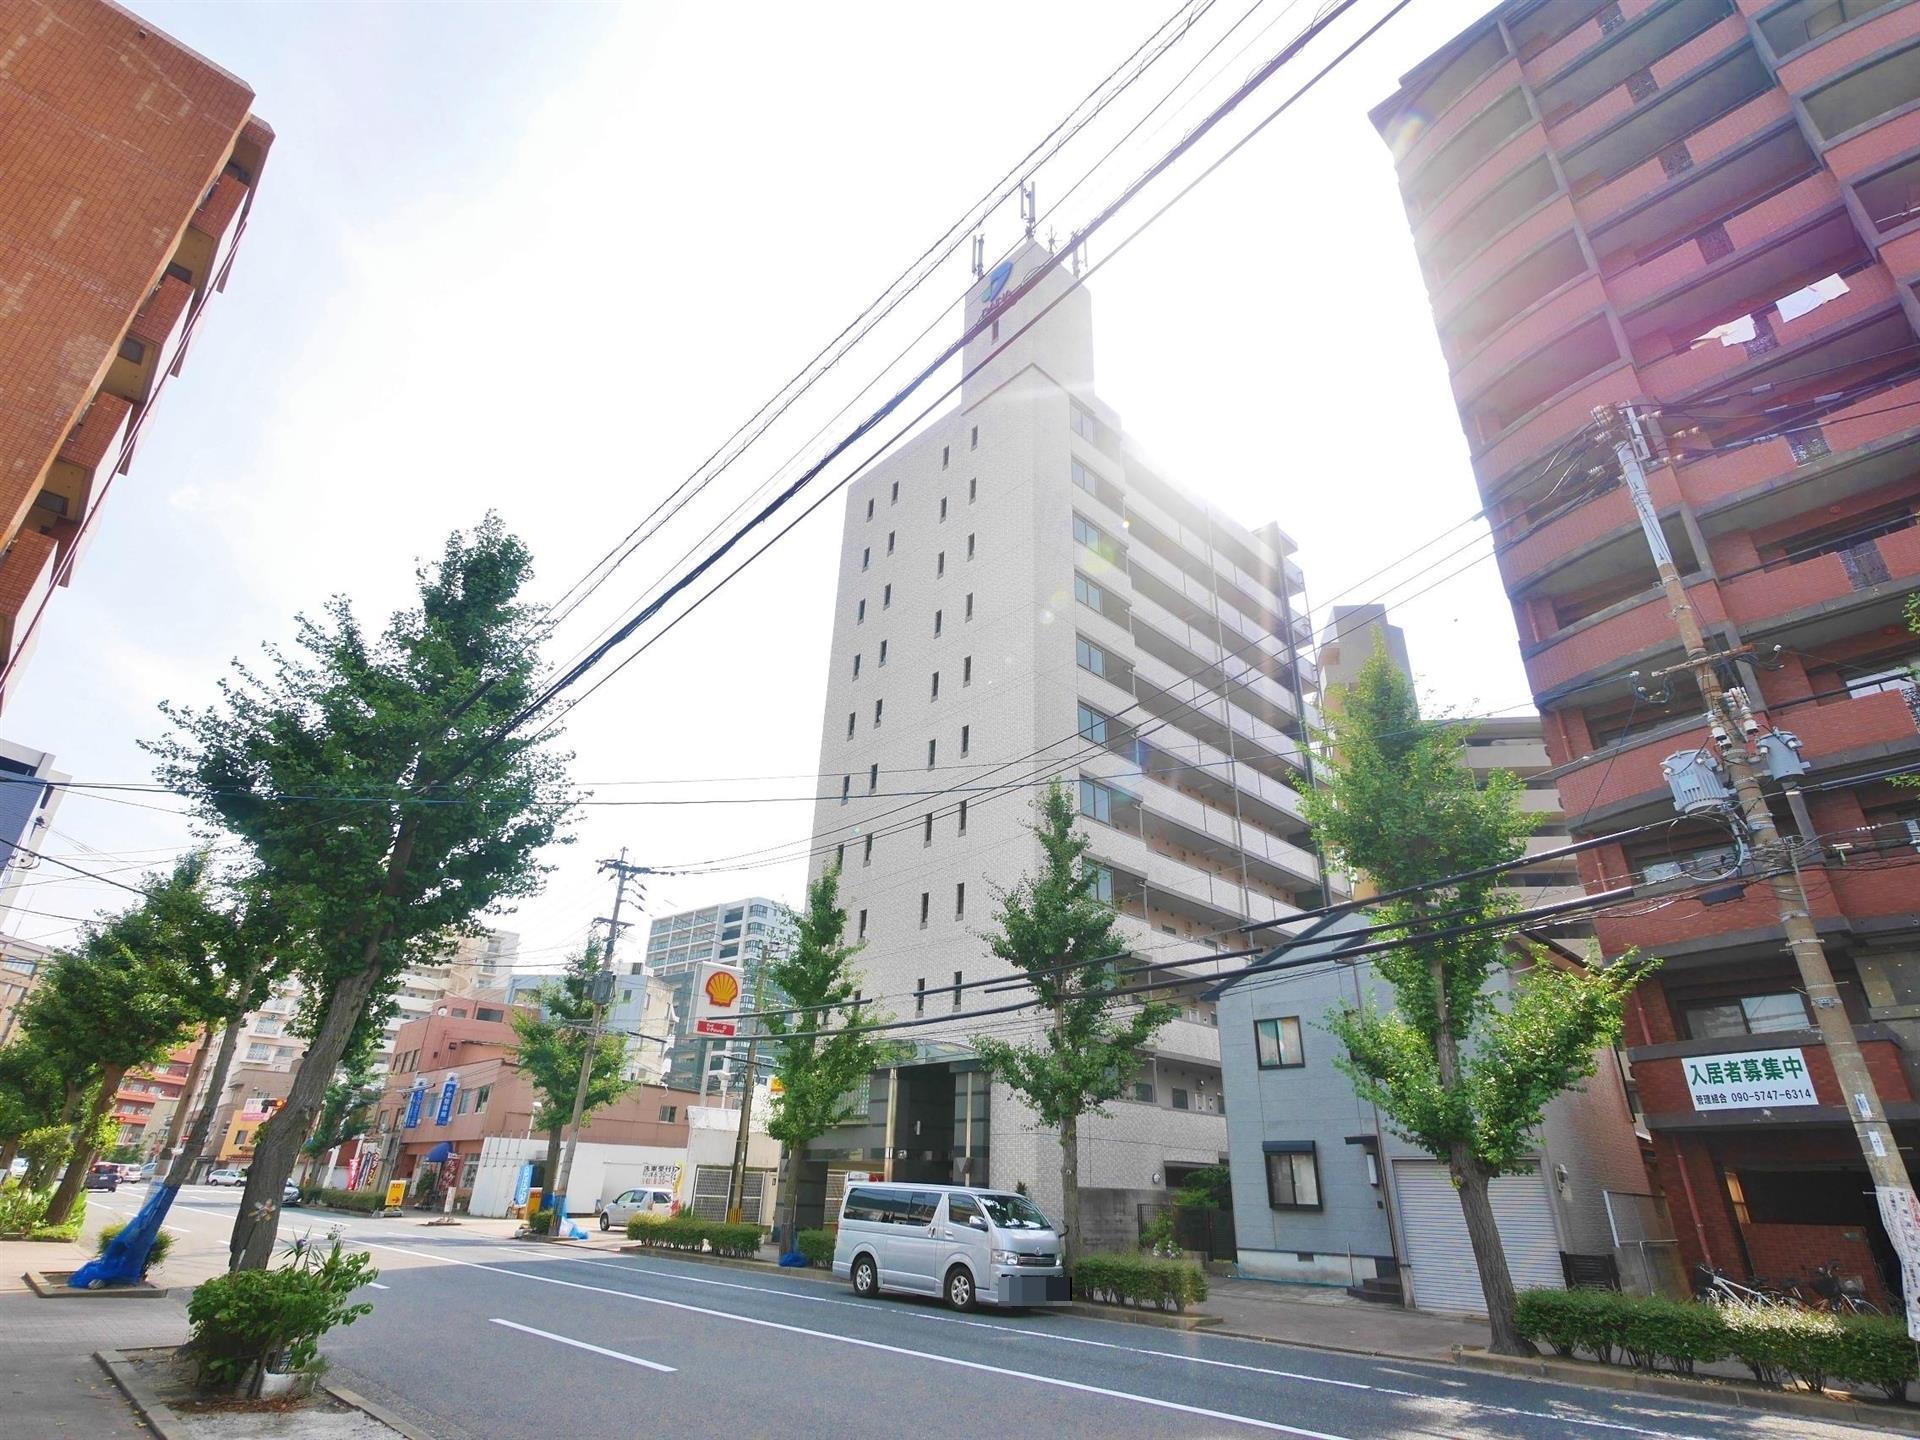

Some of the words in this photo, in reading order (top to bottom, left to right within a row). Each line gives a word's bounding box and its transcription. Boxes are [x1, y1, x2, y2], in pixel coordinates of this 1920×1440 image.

[1689, 1055, 1804, 1087] 入居者募集中
[1695, 1093, 1728, 1106] 管理組合
[1731, 1089, 1812, 1103] 090-5747-6314
